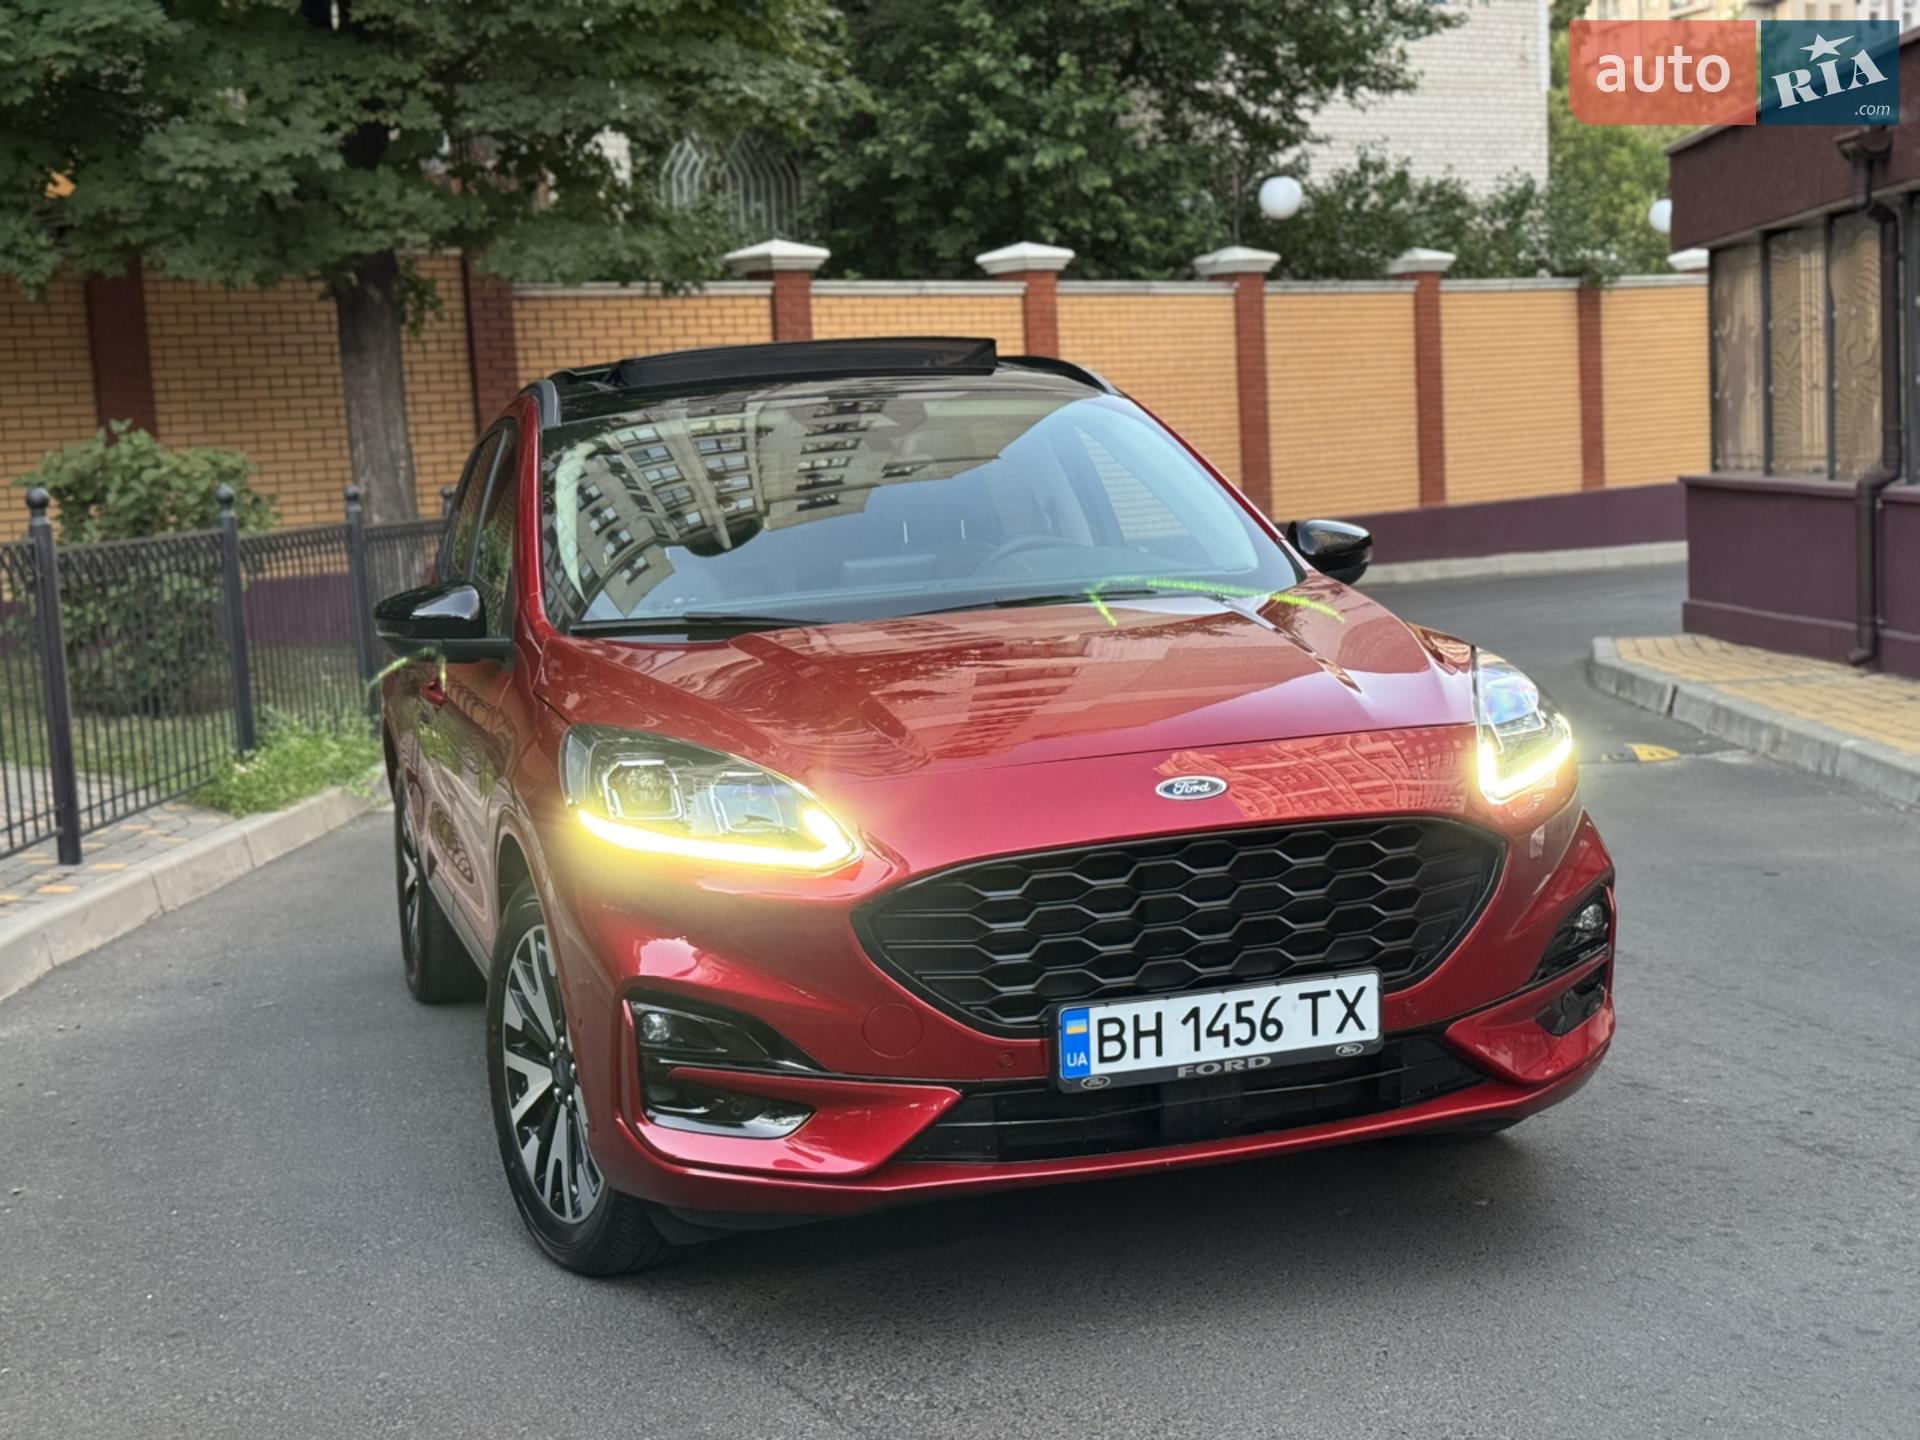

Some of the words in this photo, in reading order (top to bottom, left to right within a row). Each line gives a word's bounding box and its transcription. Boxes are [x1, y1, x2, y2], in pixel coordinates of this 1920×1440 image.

[1172, 780, 1212, 795] Ford
[1097, 1011, 1163, 1064] BH
[1180, 996, 1284, 1052] 1456
[1298, 986, 1367, 1036] TX
[1066, 1052, 1088, 1067] UA
[1177, 1056, 1272, 1079] FORD
